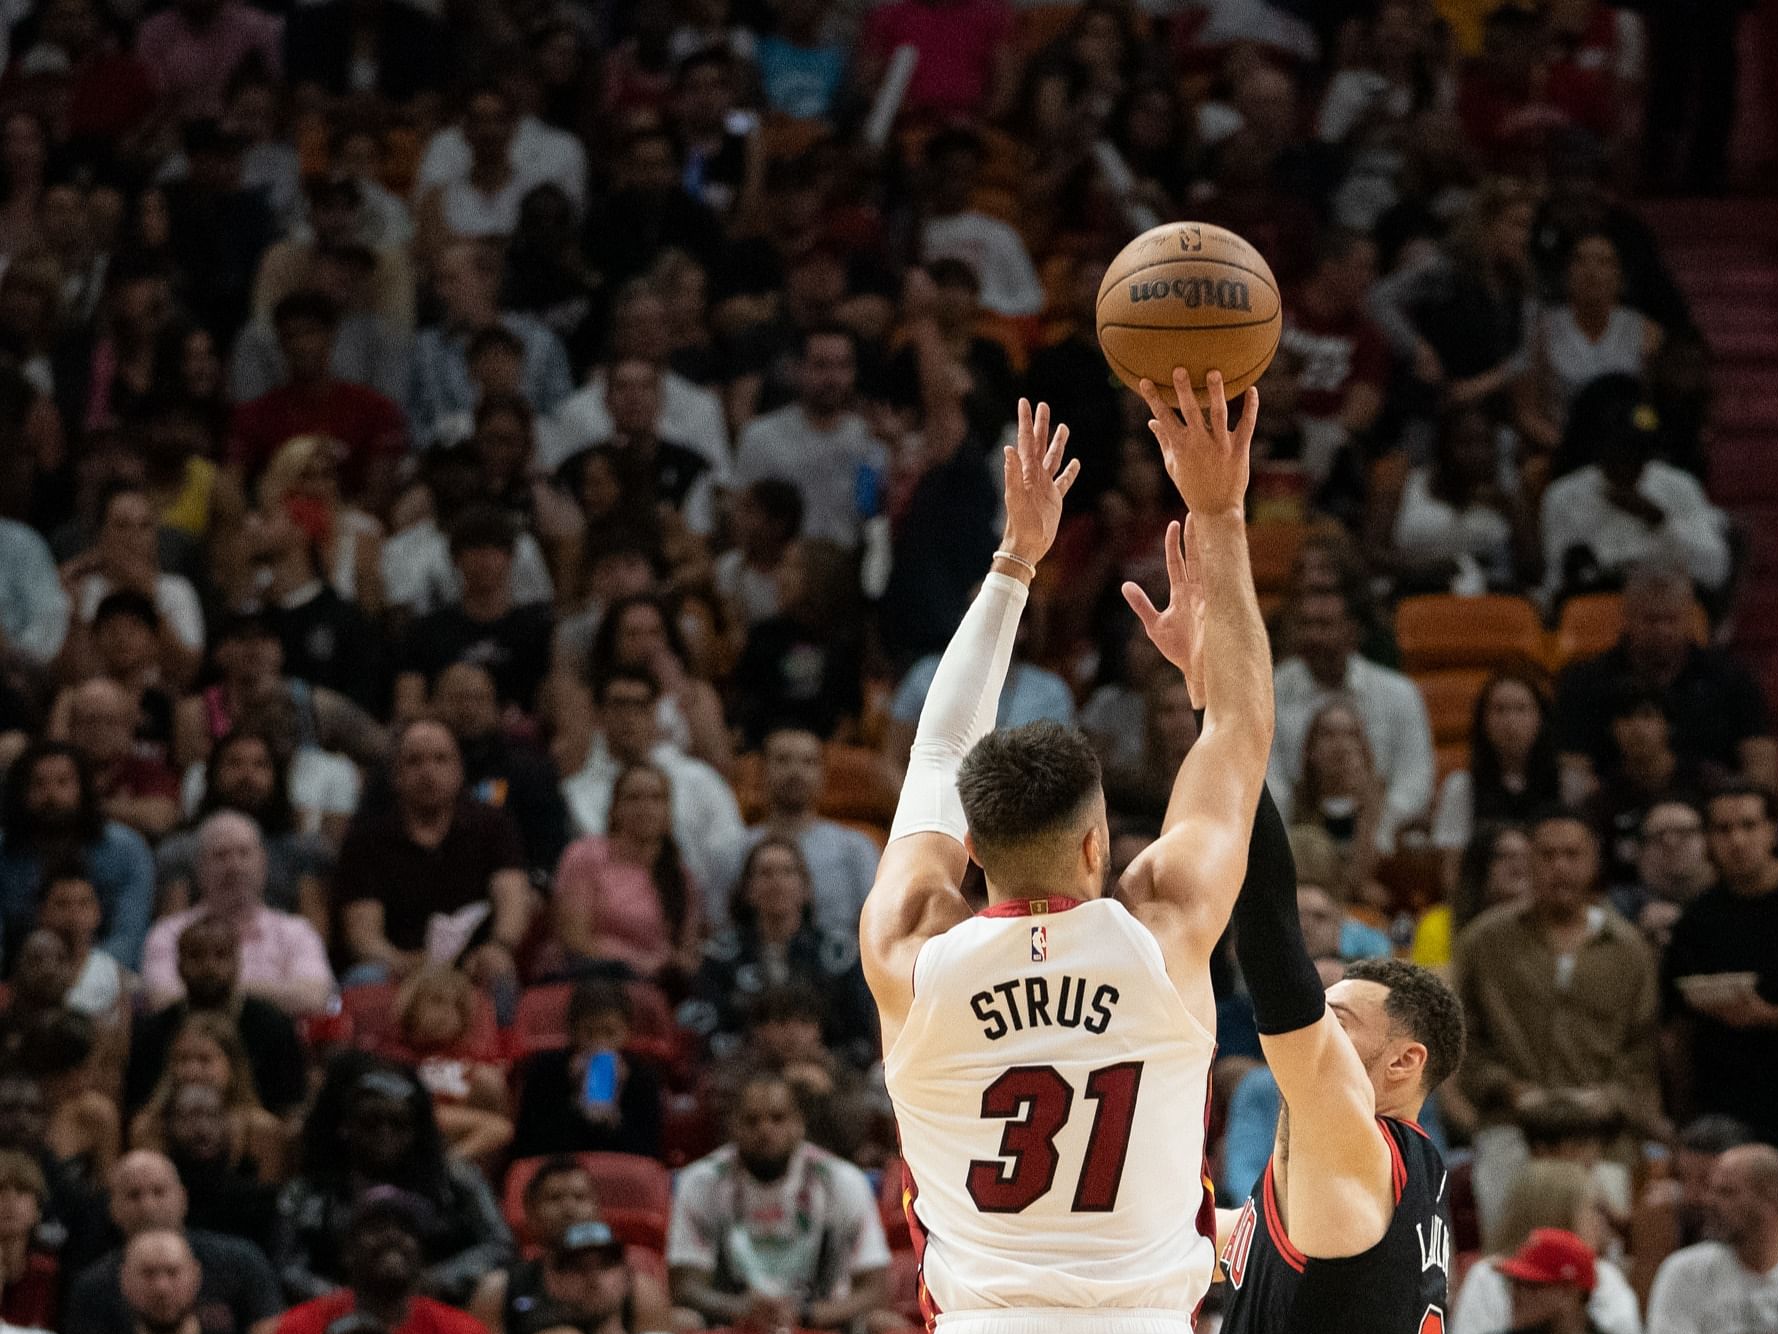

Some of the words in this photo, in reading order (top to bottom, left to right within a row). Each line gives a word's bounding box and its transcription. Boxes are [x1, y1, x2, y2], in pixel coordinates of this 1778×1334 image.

[1129, 276, 1253, 314] Wilson
[969, 974, 1121, 1042] STRUS
[964, 1060, 1146, 1215] 31
